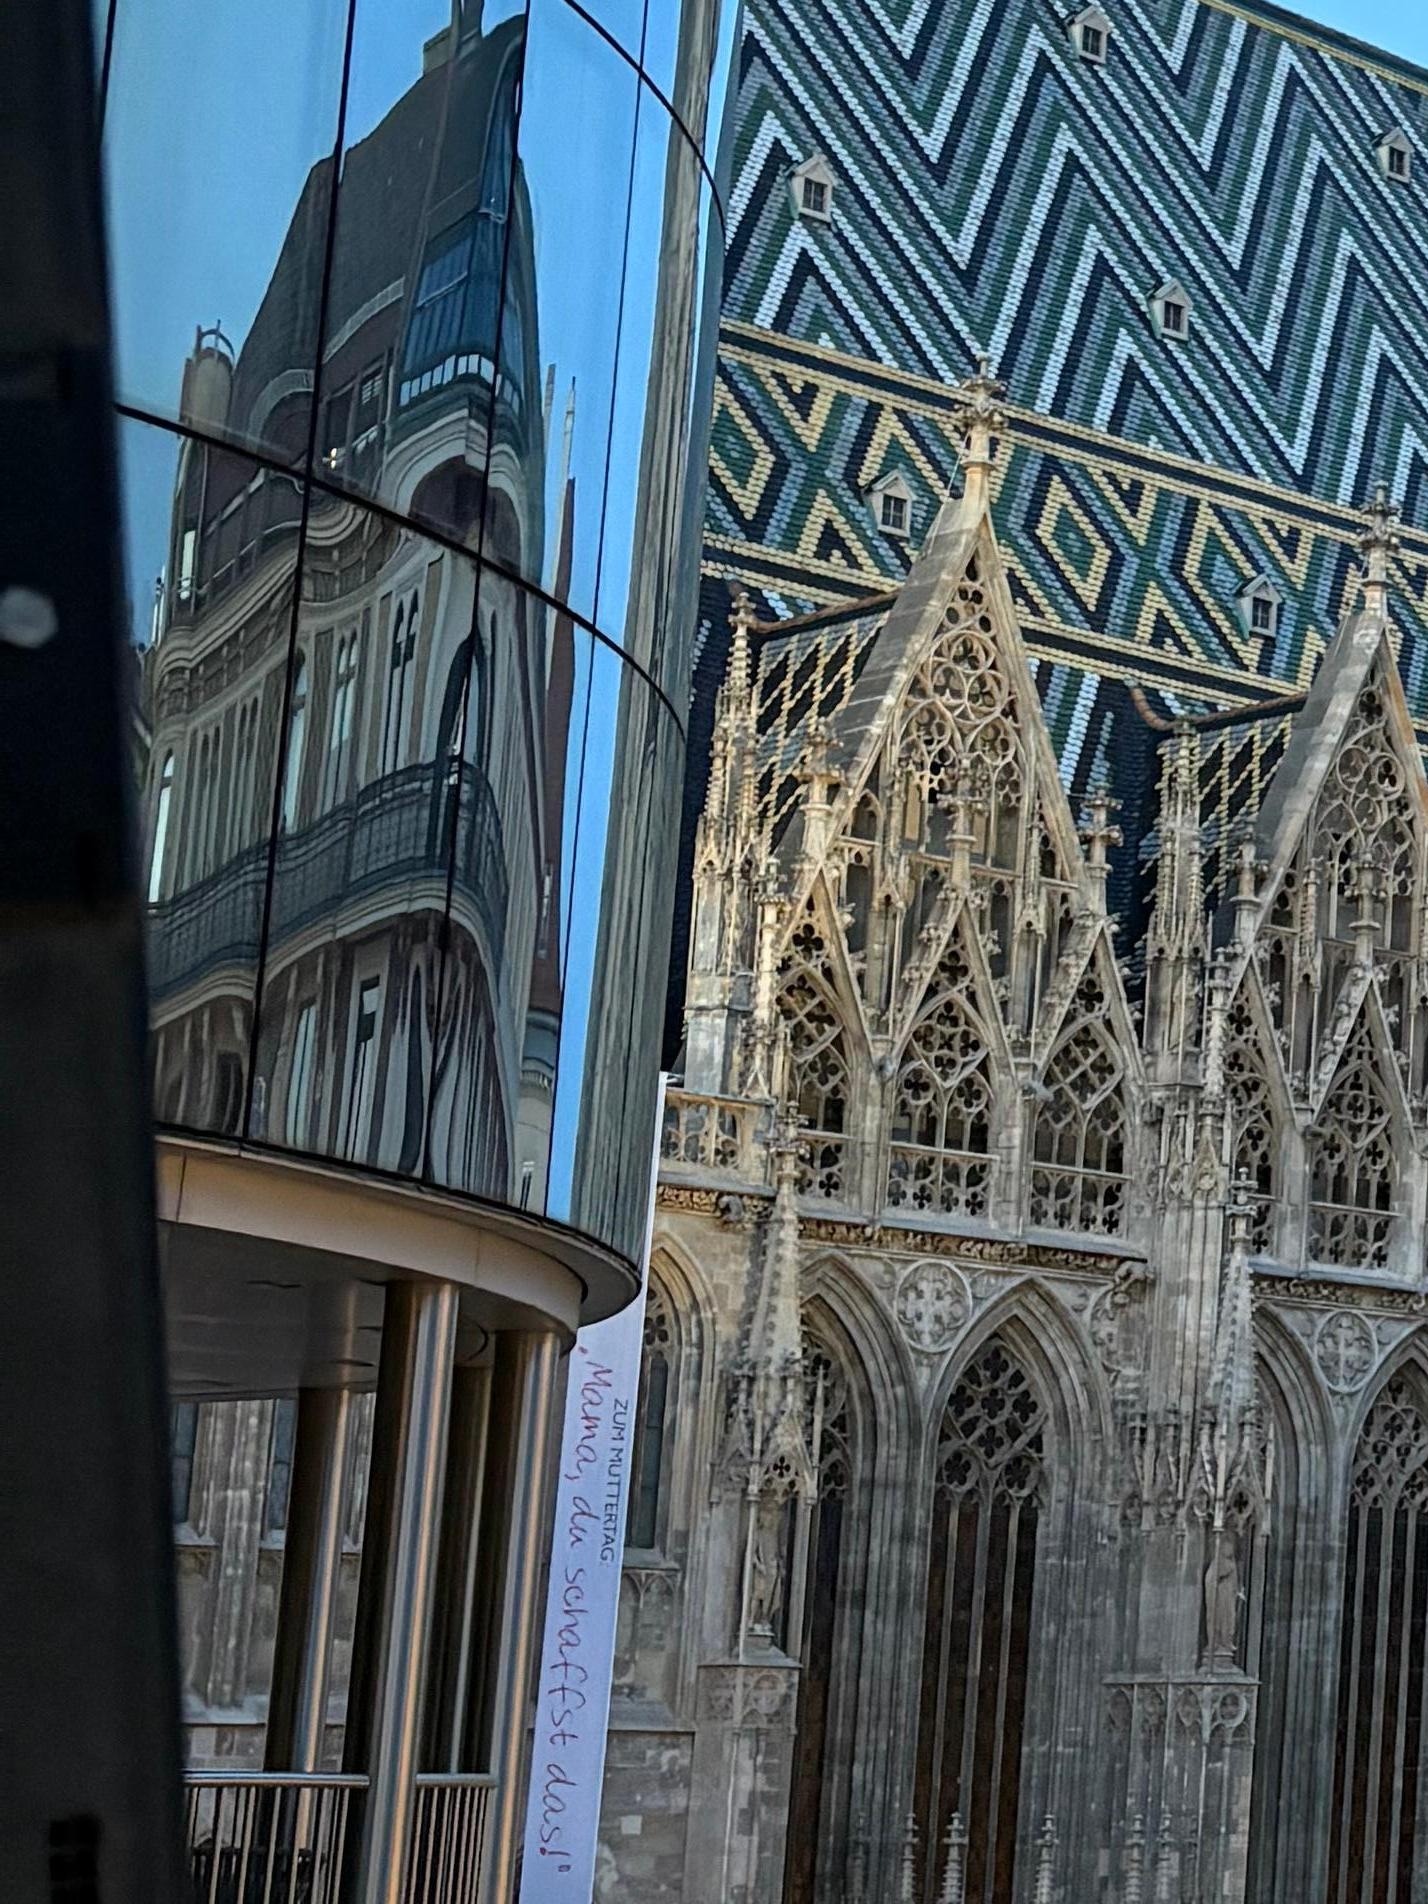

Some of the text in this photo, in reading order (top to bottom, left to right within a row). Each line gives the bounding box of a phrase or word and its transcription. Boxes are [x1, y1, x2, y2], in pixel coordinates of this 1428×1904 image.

[610, 1398, 629, 1441] ZUM
[568, 1496, 601, 1547] du
[547, 1567, 589, 1747] schaffst
